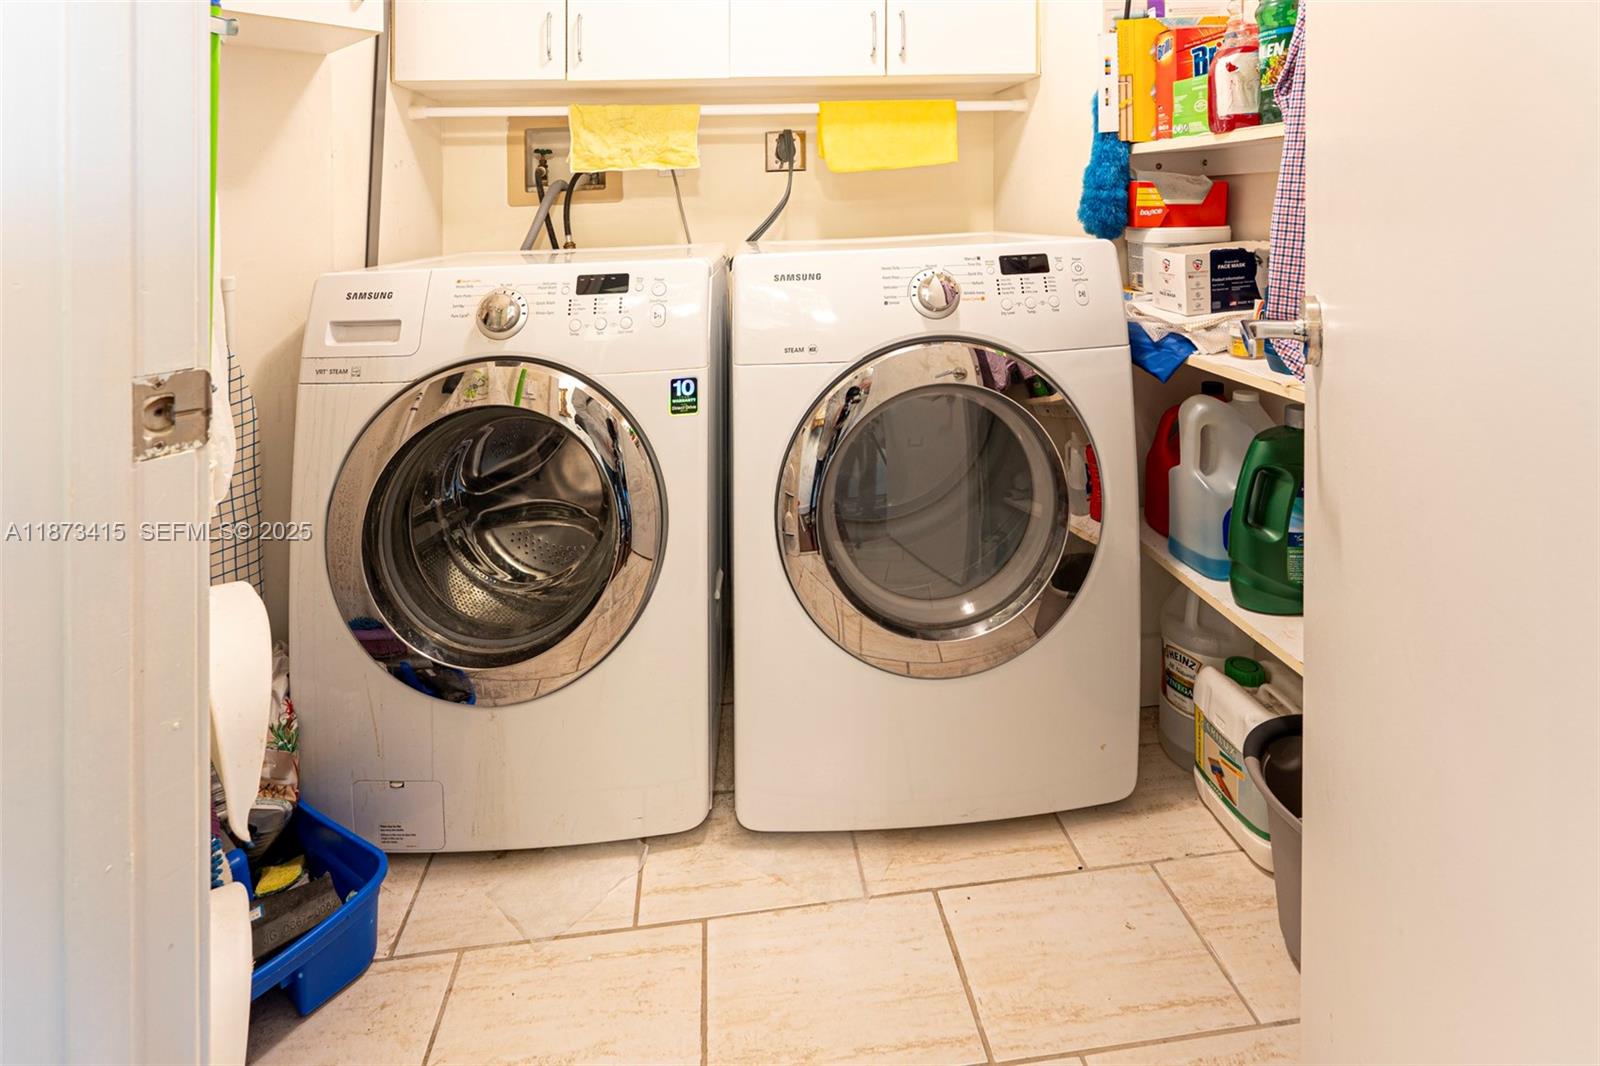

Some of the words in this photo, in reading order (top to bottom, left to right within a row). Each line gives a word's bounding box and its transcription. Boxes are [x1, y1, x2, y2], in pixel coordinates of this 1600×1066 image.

[773, 272, 822, 282] SAMSUNG
[345, 291, 394, 301] SAMSUNG
[784, 346, 805, 354] STEAM
[672, 379, 696, 397] 10
[1166, 649, 1197, 671] HEINZ
[1167, 676, 1194, 697] VINEGA
